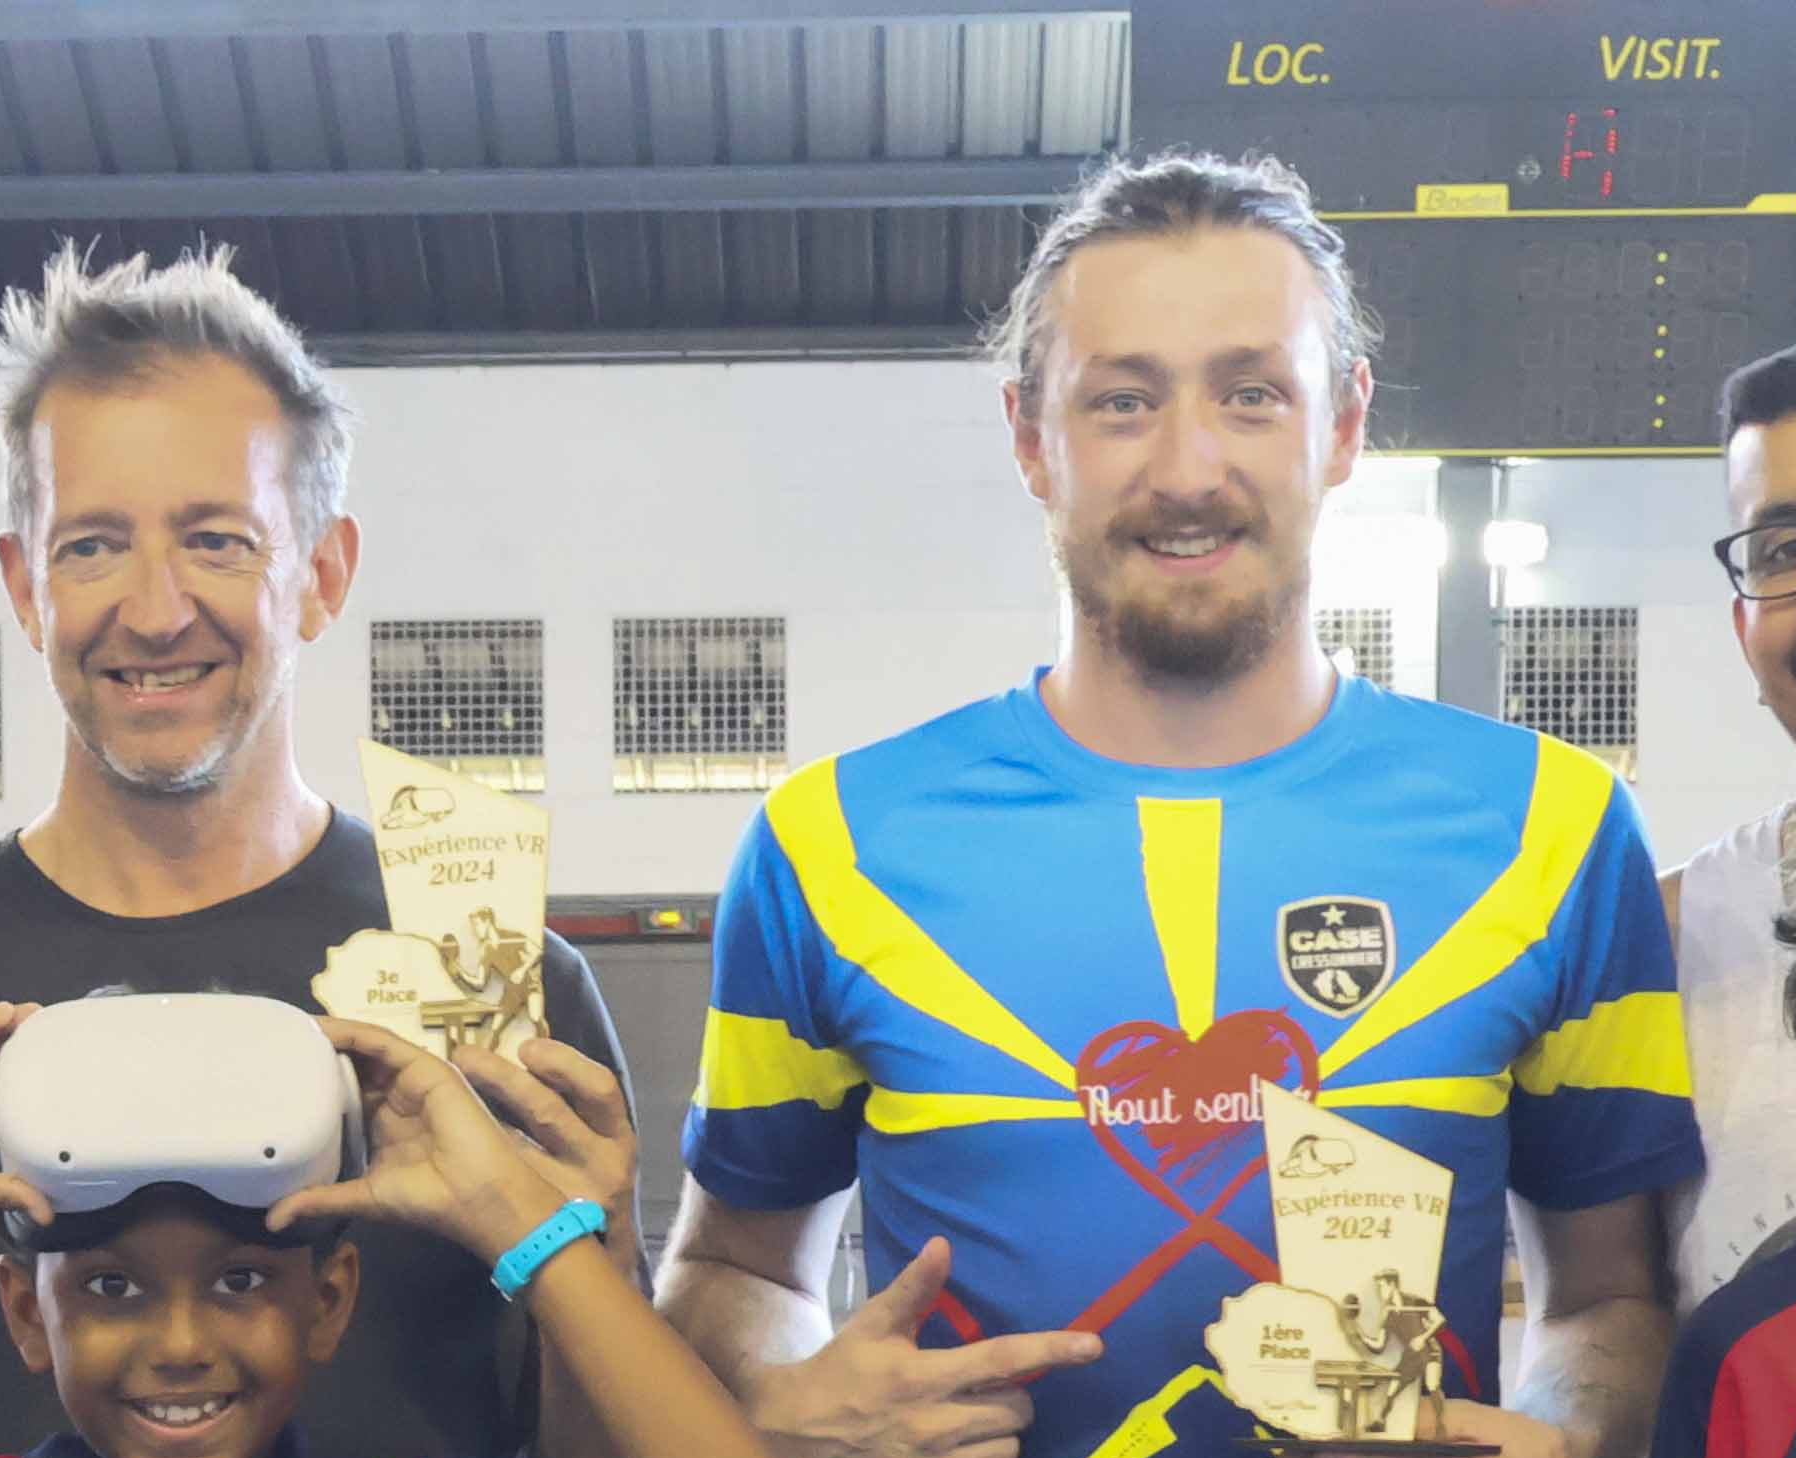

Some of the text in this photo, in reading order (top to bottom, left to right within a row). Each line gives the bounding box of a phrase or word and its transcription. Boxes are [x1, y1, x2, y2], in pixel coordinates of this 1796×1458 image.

[1227, 42, 1331, 86] LOC.
[1600, 35, 1722, 80] VISIT.
[514, 833, 546, 855] VR
[428, 858, 496, 886] 2024
[1290, 927, 1383, 952] CASE
[376, 969, 399, 985] 3e
[366, 986, 417, 1004] Place
[1412, 1192, 1446, 1218] VR
[1322, 1215, 1393, 1240] 2024
[1261, 1324, 1304, 1342] 1ère
[1259, 1343, 1311, 1361] Place
